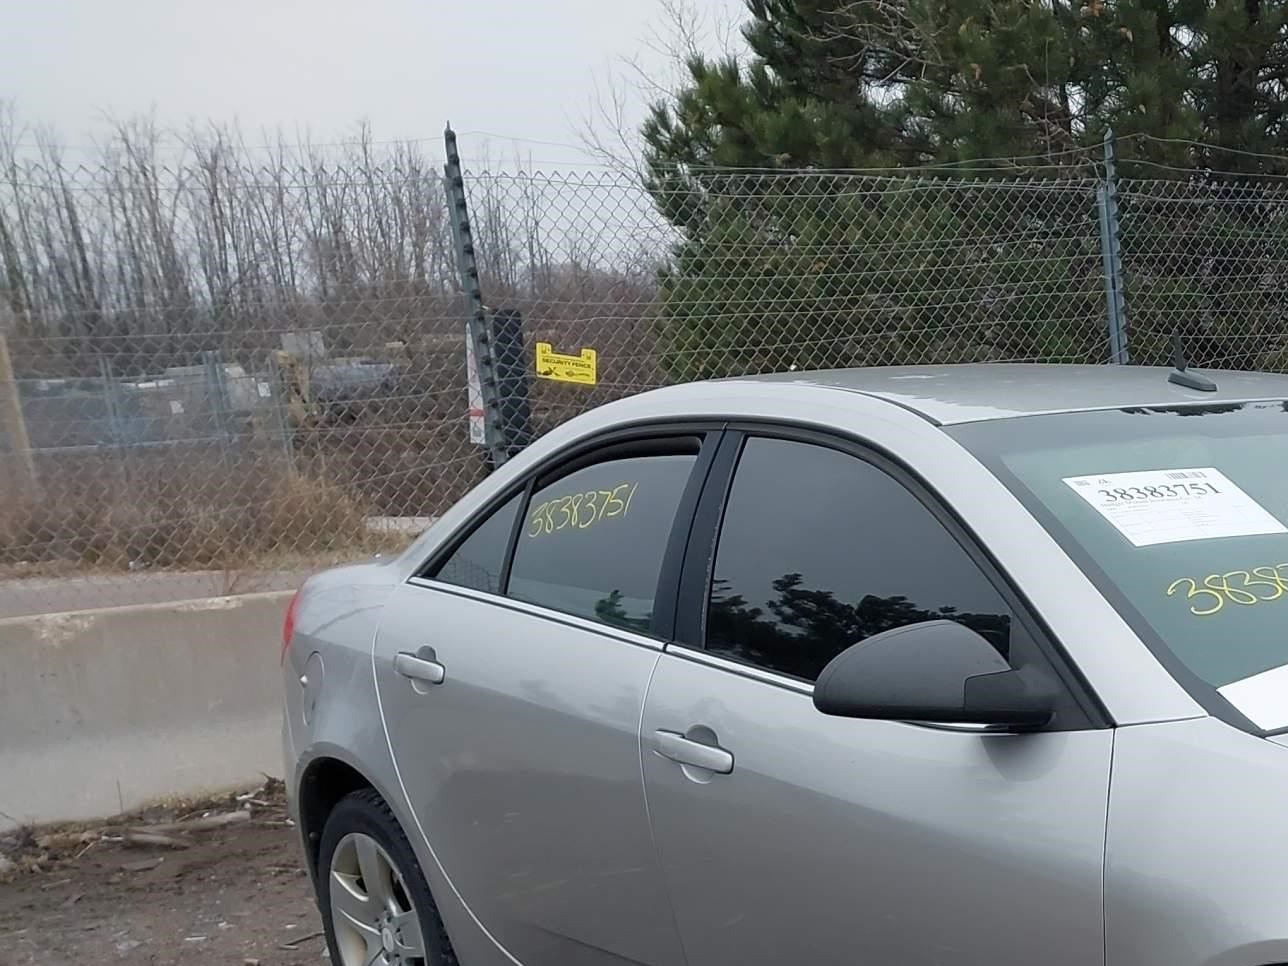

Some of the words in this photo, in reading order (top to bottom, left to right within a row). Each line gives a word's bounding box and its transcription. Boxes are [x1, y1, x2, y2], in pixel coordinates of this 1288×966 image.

[542, 357, 571, 367] SECURITY
[571, 361, 592, 369] FENCE
[1097, 482, 1223, 502] 38383751
[528, 481, 640, 538] 38383751
